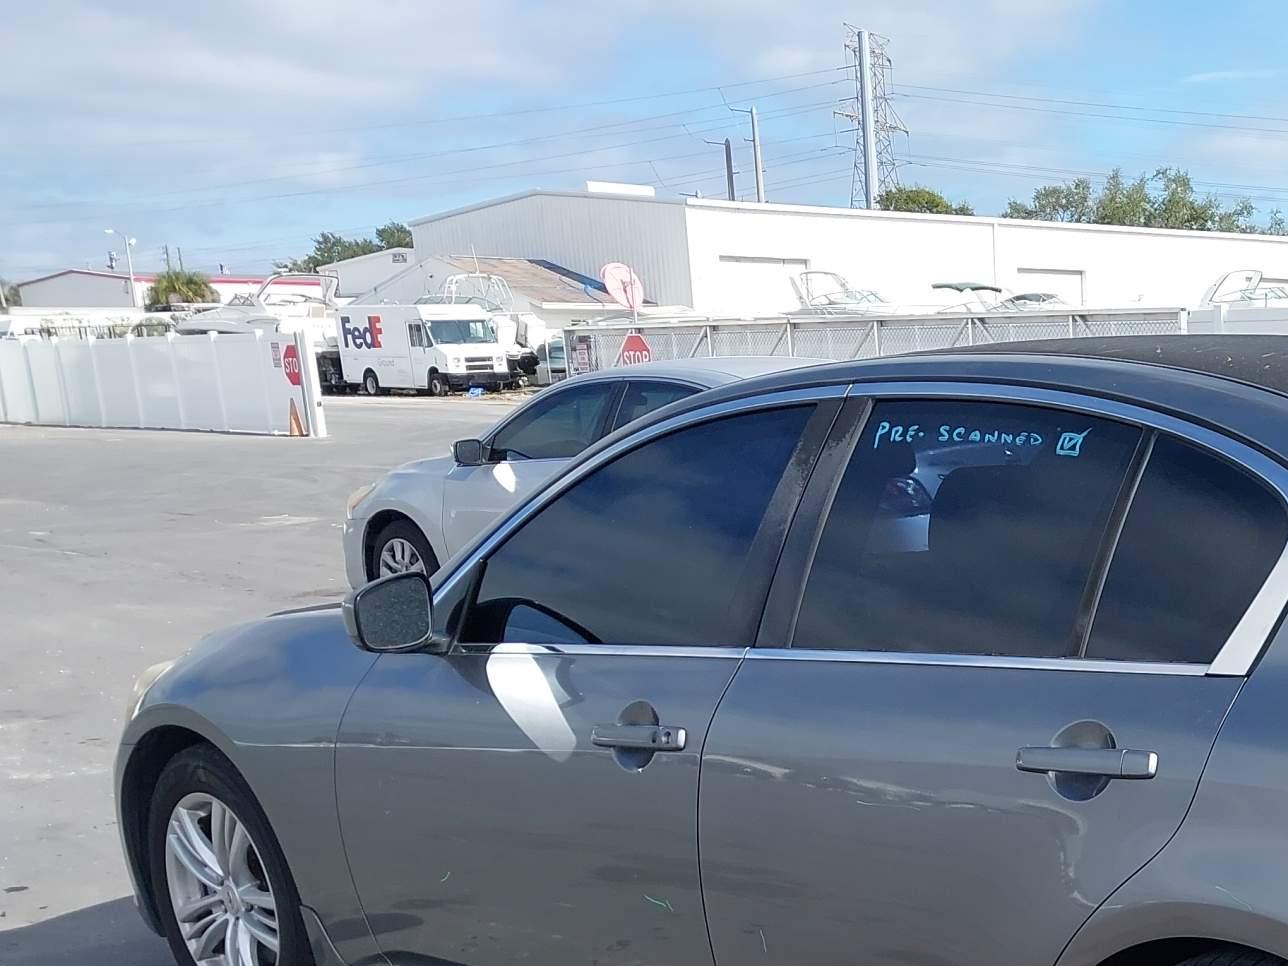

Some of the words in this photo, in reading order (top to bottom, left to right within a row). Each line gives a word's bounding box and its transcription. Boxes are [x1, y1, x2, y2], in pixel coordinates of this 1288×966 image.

[284, 357, 299, 373] STO
[623, 350, 650, 366] STOP
[938, 424, 1043, 446] SCANNED
